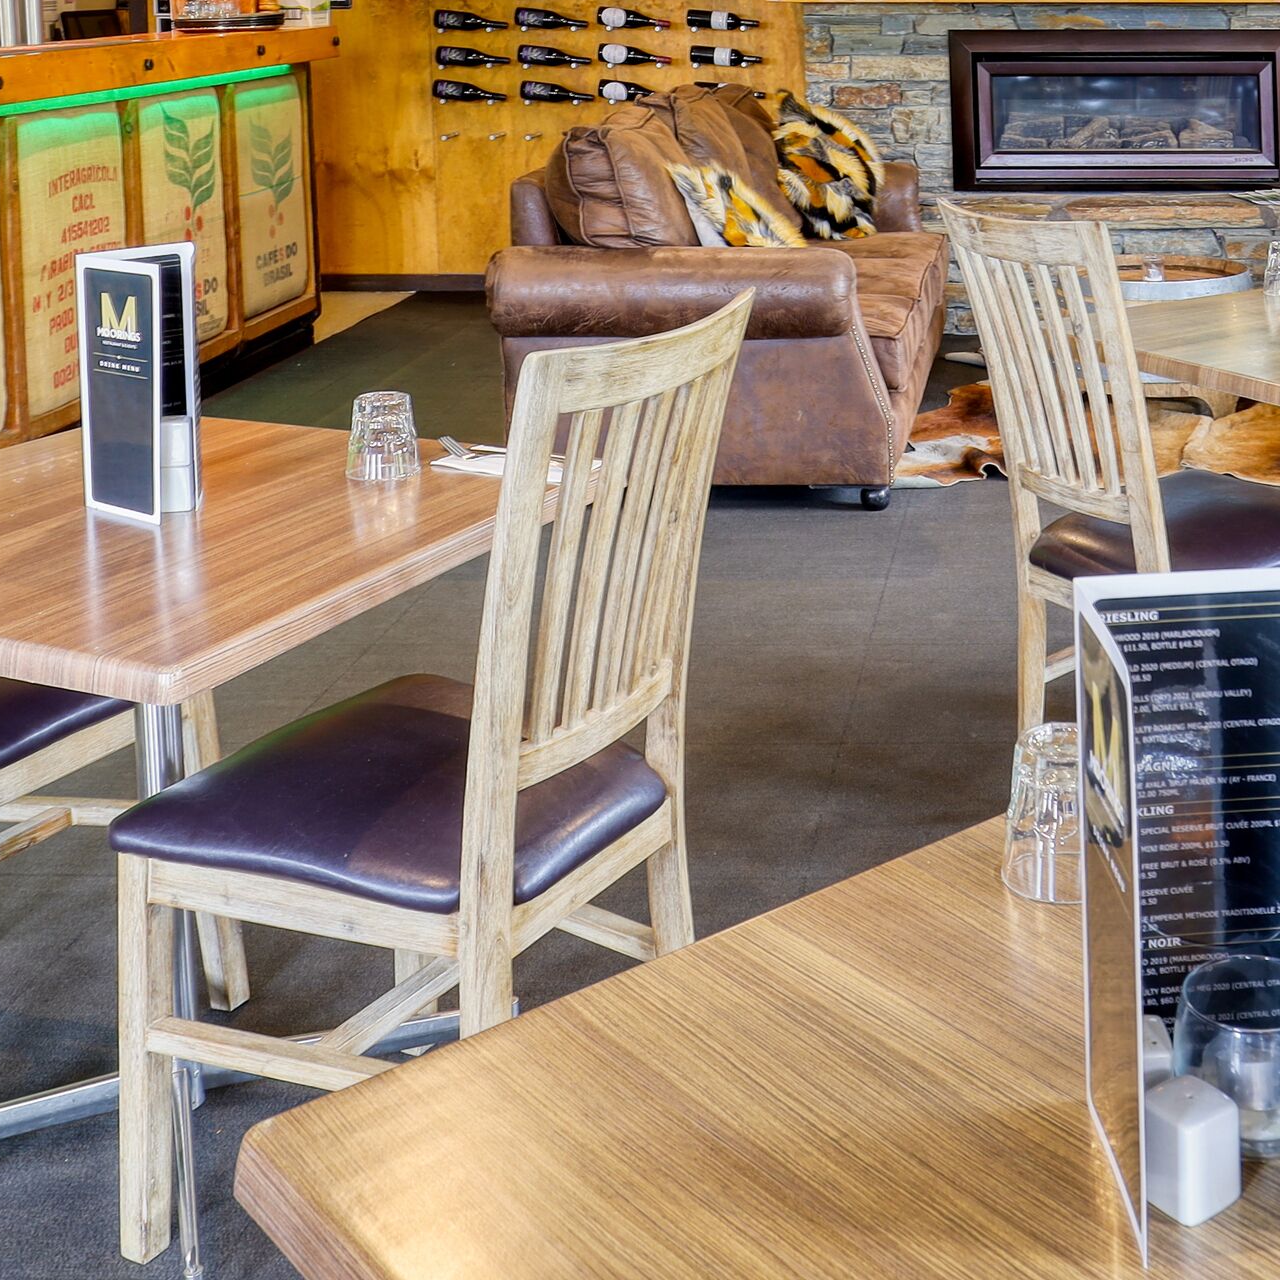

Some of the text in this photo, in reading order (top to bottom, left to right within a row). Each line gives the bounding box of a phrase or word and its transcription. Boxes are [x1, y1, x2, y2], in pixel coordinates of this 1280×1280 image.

[285, 242, 298, 259] DO
[204, 277, 218, 295] DO
[100, 292, 137, 332] M
[96, 326, 141, 342] MOORINGS
[1230, 656, 1259, 667] OTAGO)
[1247, 773, 1277, 783] FRANCE)
[1140, 825, 1170, 836] SPECIAL
[1172, 823, 1204, 832] RESERVE
[1141, 861, 1160, 870] FREE
[1150, 912, 1184, 922] EMPEROR
[1148, 936, 1183, 949] NOIR
[1159, 965, 1186, 975] BOTTLE
[1231, 979, 1266, 991] (CENTRAL
